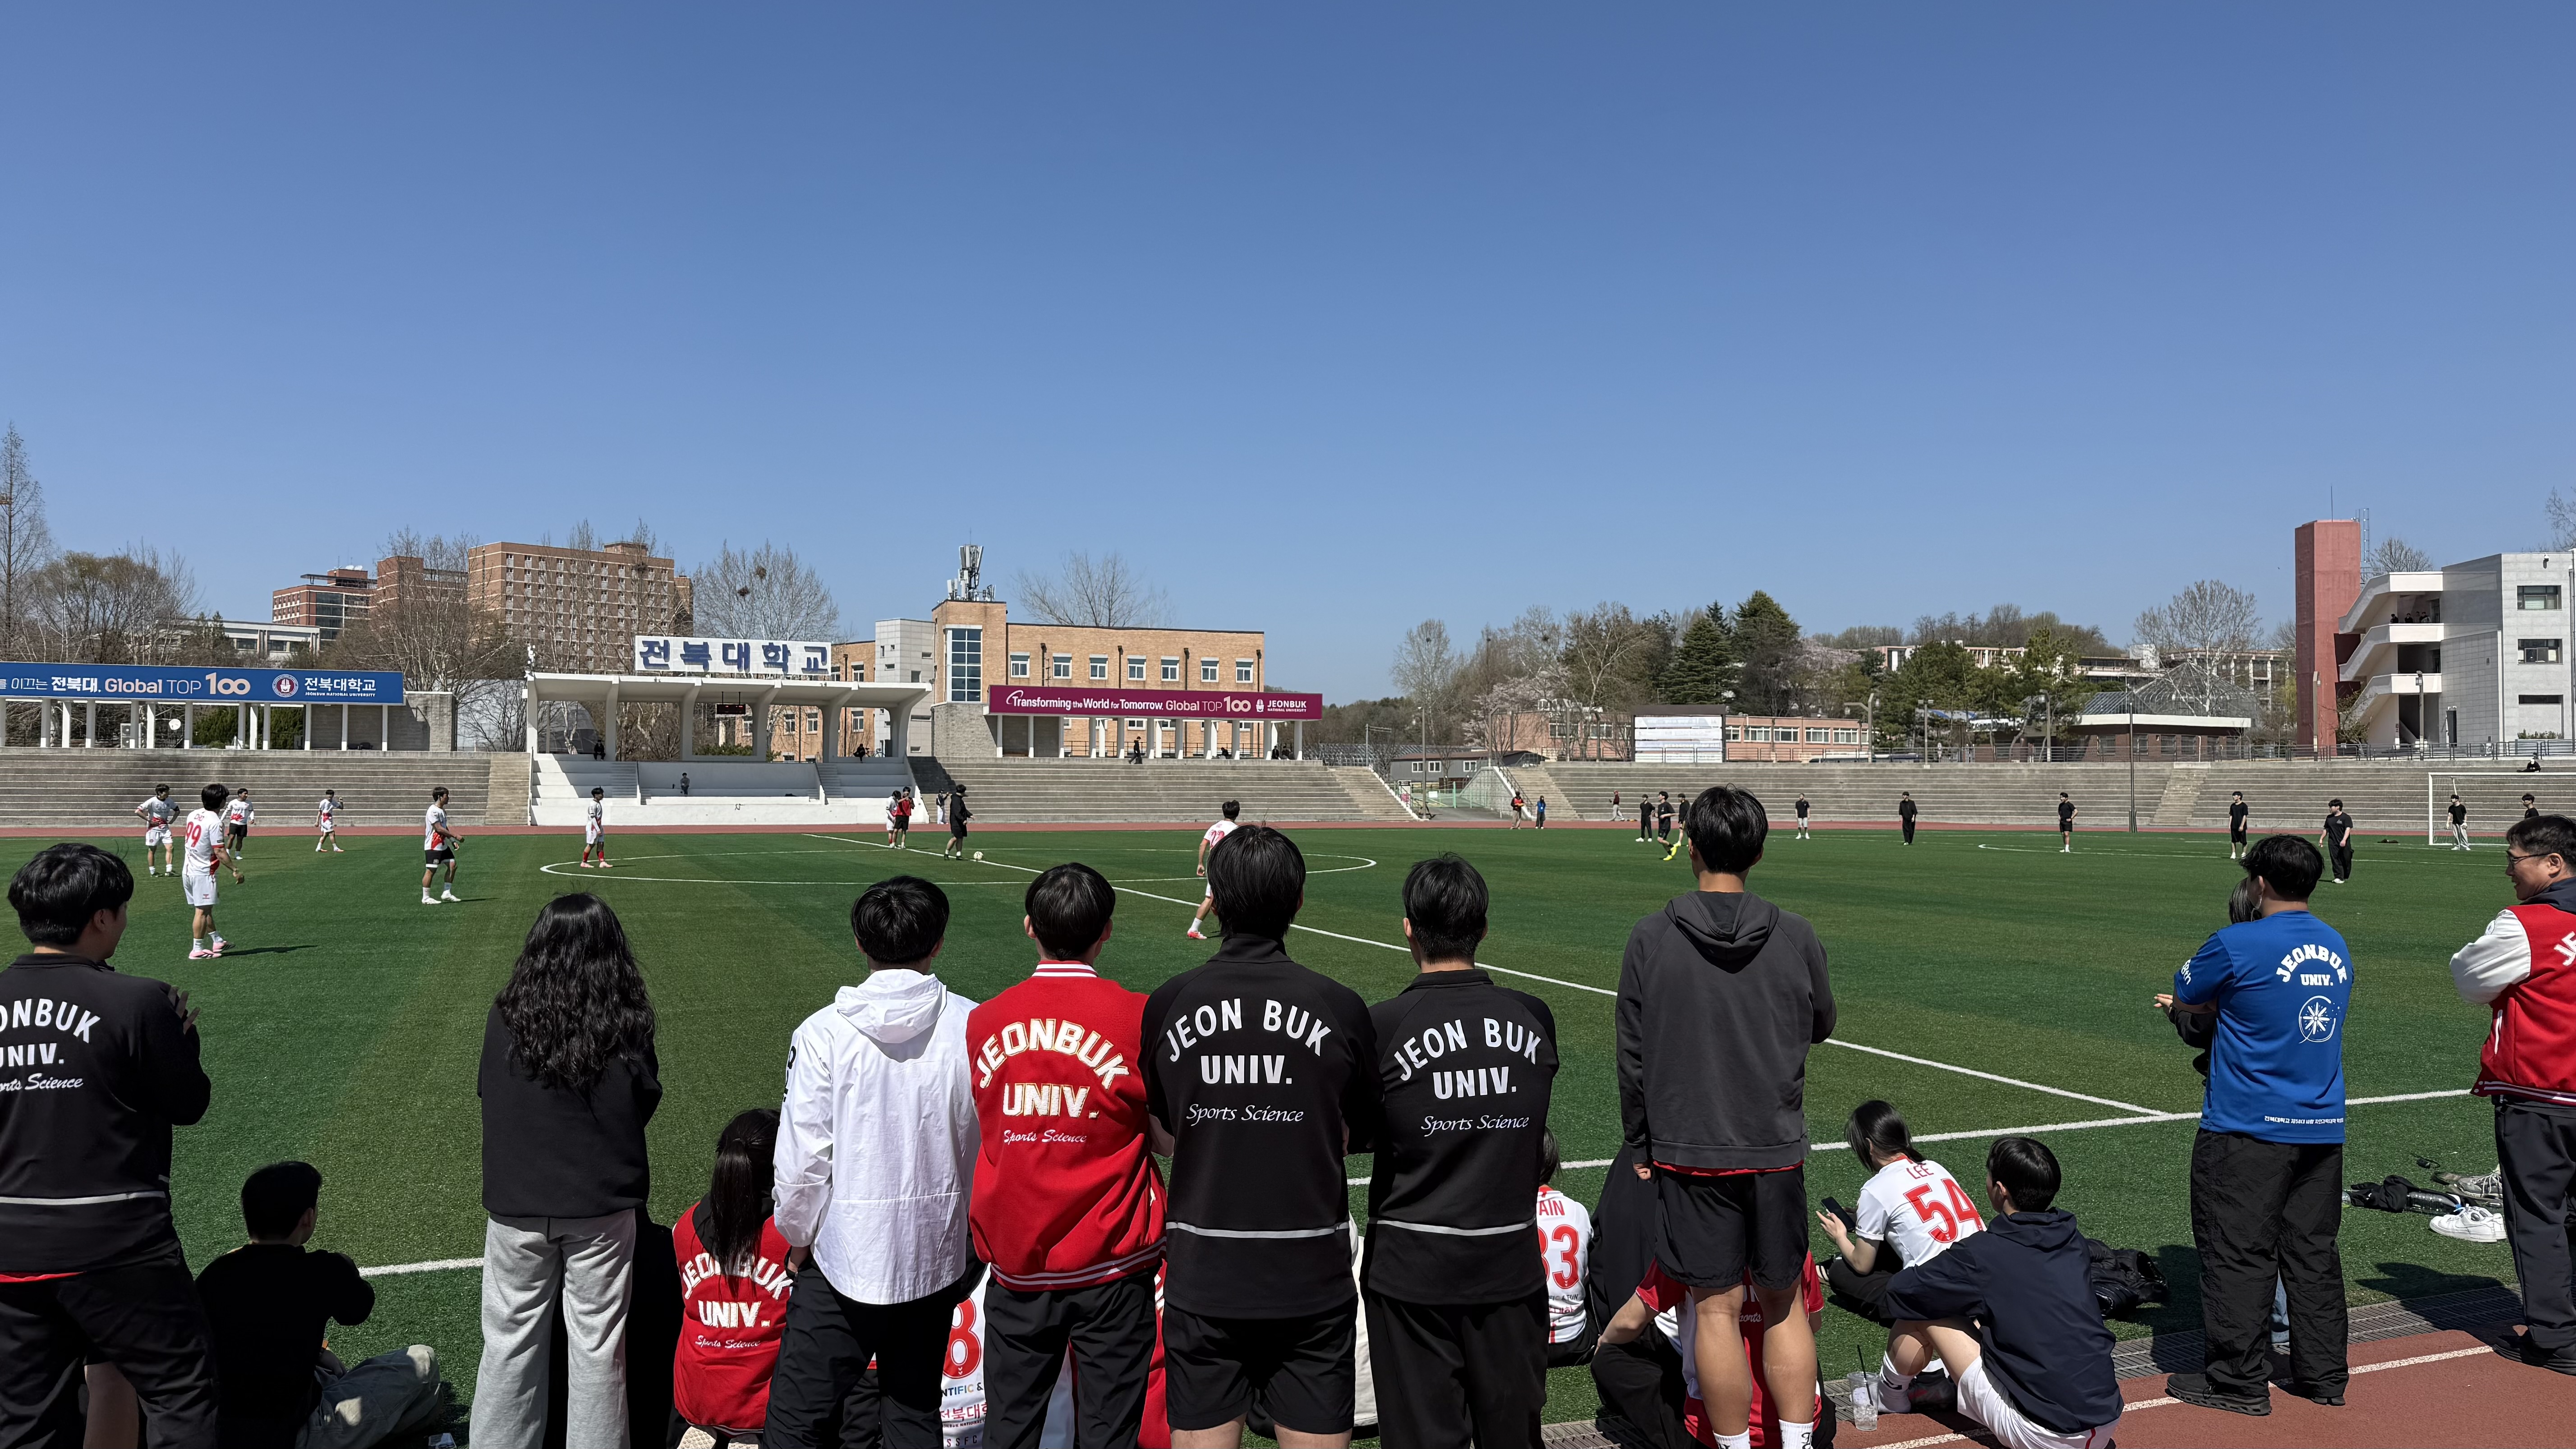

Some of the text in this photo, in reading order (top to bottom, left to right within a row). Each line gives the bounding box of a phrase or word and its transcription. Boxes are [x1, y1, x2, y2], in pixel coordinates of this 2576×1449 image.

[639, 639, 828, 675] 전북대학교
[11, 678, 47, 690] 이끄는
[51, 677, 101, 692] 전북대.
[105, 678, 162, 693] Global
[166, 680, 201, 694] TOP
[206, 672, 250, 695] 100
[304, 677, 376, 691] 전북대학교
[1012, 696, 1072, 710] Transforming
[1083, 698, 1109, 709] World
[1120, 699, 1164, 710] Tomorrow.
[1166, 700, 1200, 711] Global
[1202, 701, 1222, 712] TOP
[1224, 696, 1251, 712] 100
[2276, 944, 2347, 984] JEONBUK
[1167, 998, 1331, 1062] JEON BUK
[977, 1018, 1129, 1090] JEONBUK
[1394, 1018, 1541, 1081] JEON BUK
[24, 1073, 83, 1090] Science
[1201, 1055, 1292, 1084] UNIV.
[1433, 1066, 1517, 1099] UNIV.
[1003, 1083, 1099, 1119] UNIV.
[1187, 1104, 1304, 1126] Sports Science
[1421, 1114, 1529, 1137] Sports Science
[1004, 1129, 1087, 1145] Sports Science
[1906, 1163, 1934, 1179] LEE
[1903, 1178, 1983, 1243] 54
[698, 1300, 770, 1328] UNIV.
[695, 1335, 761, 1349] Sports Science
[976, 1382, 984, 1391] &
